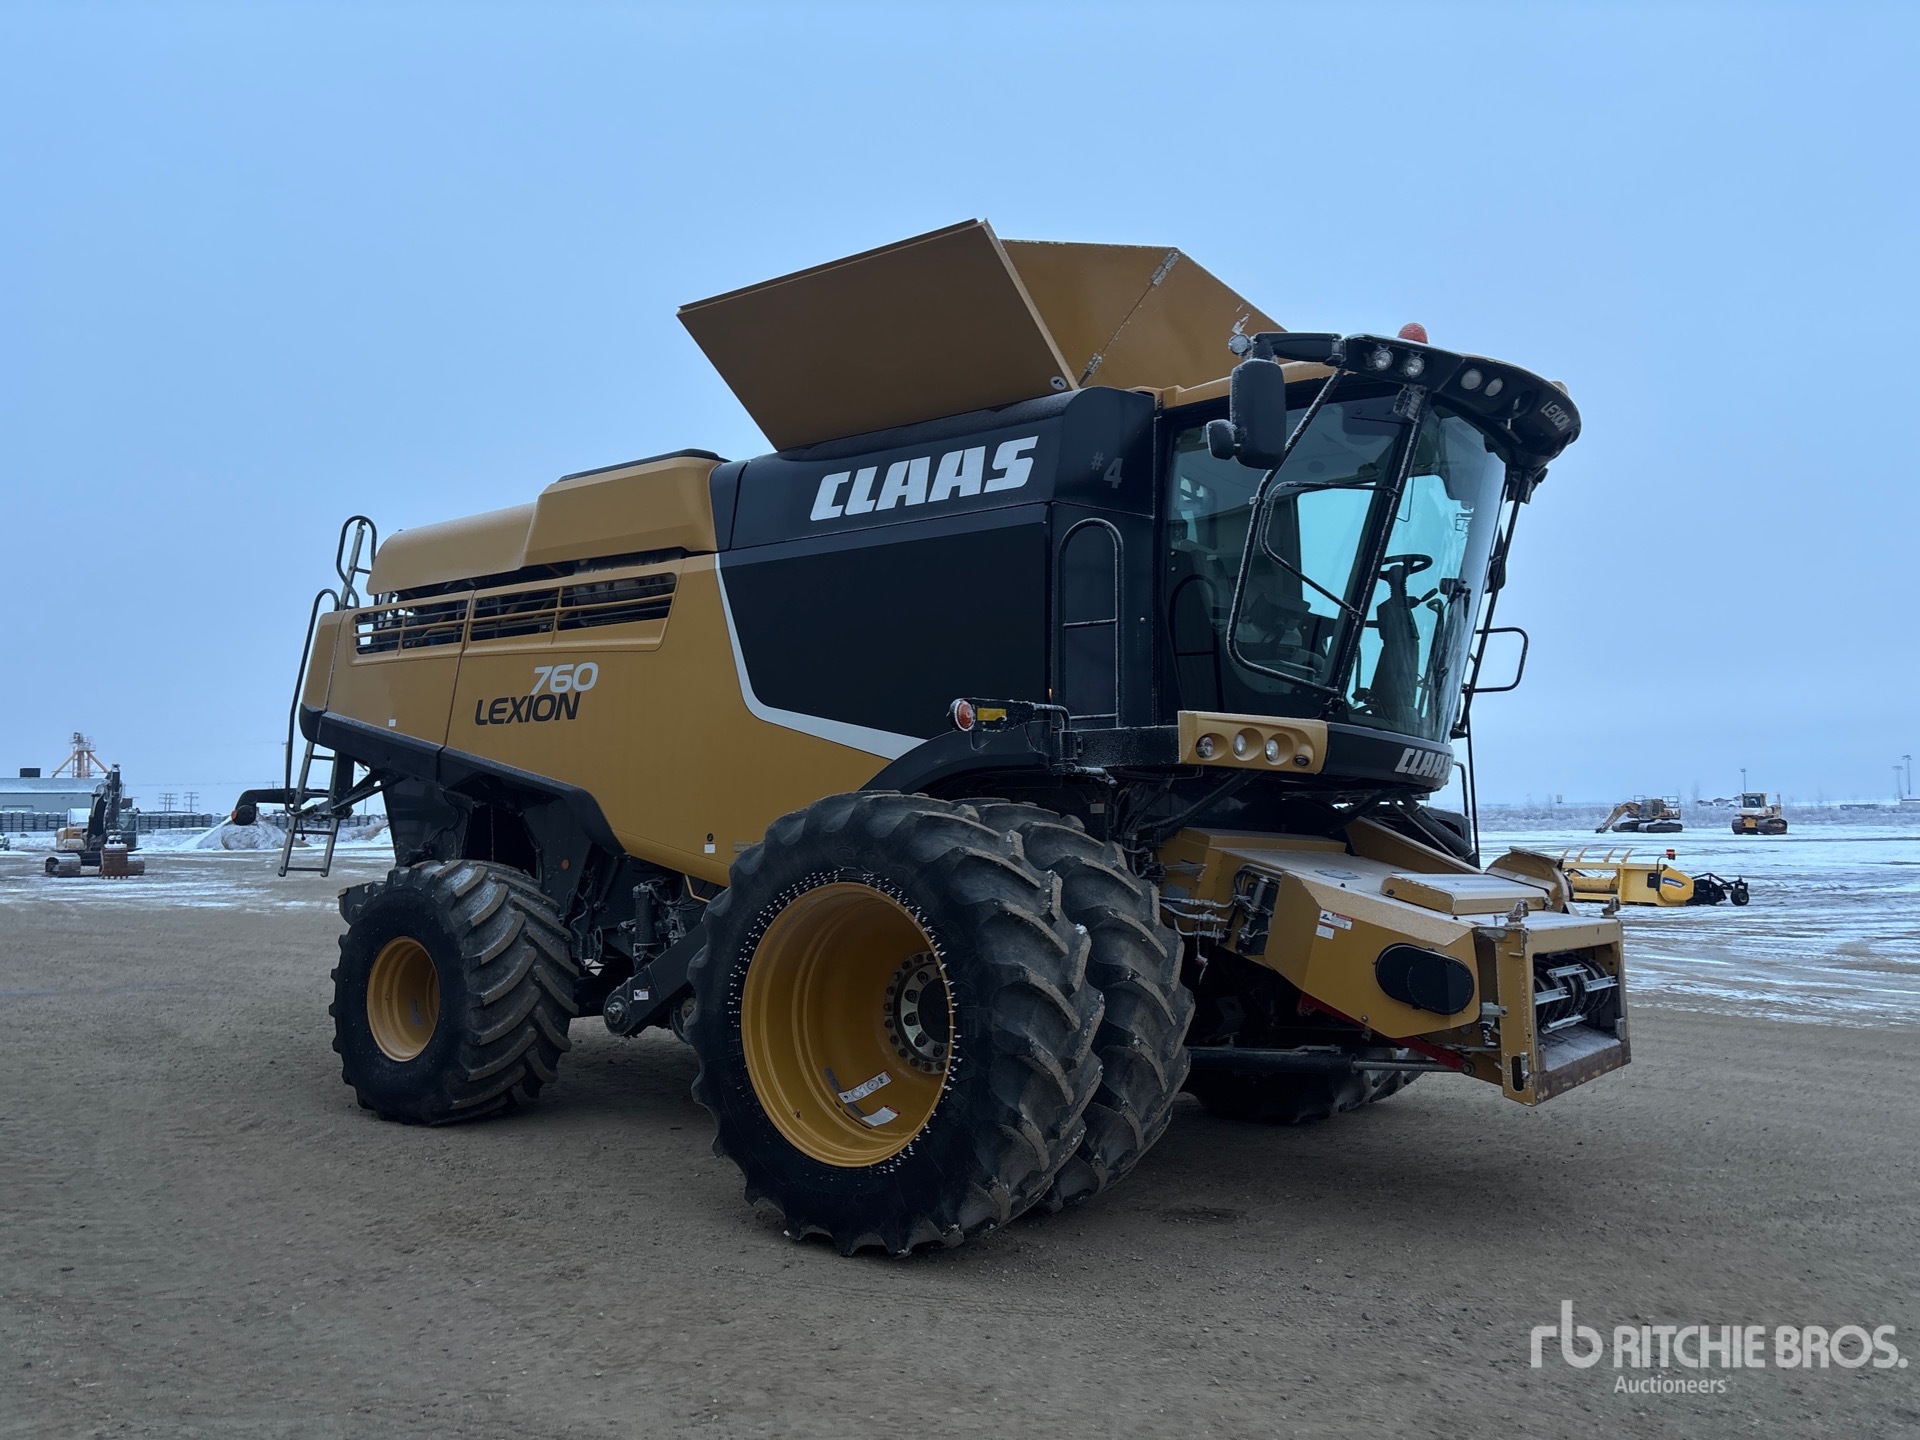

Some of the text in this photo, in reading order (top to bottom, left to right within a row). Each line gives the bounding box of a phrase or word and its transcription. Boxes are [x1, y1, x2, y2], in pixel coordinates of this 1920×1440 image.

[809, 435, 1039, 522] CLAAS
[530, 661, 599, 696] 760
[474, 691, 582, 726] LEXION
